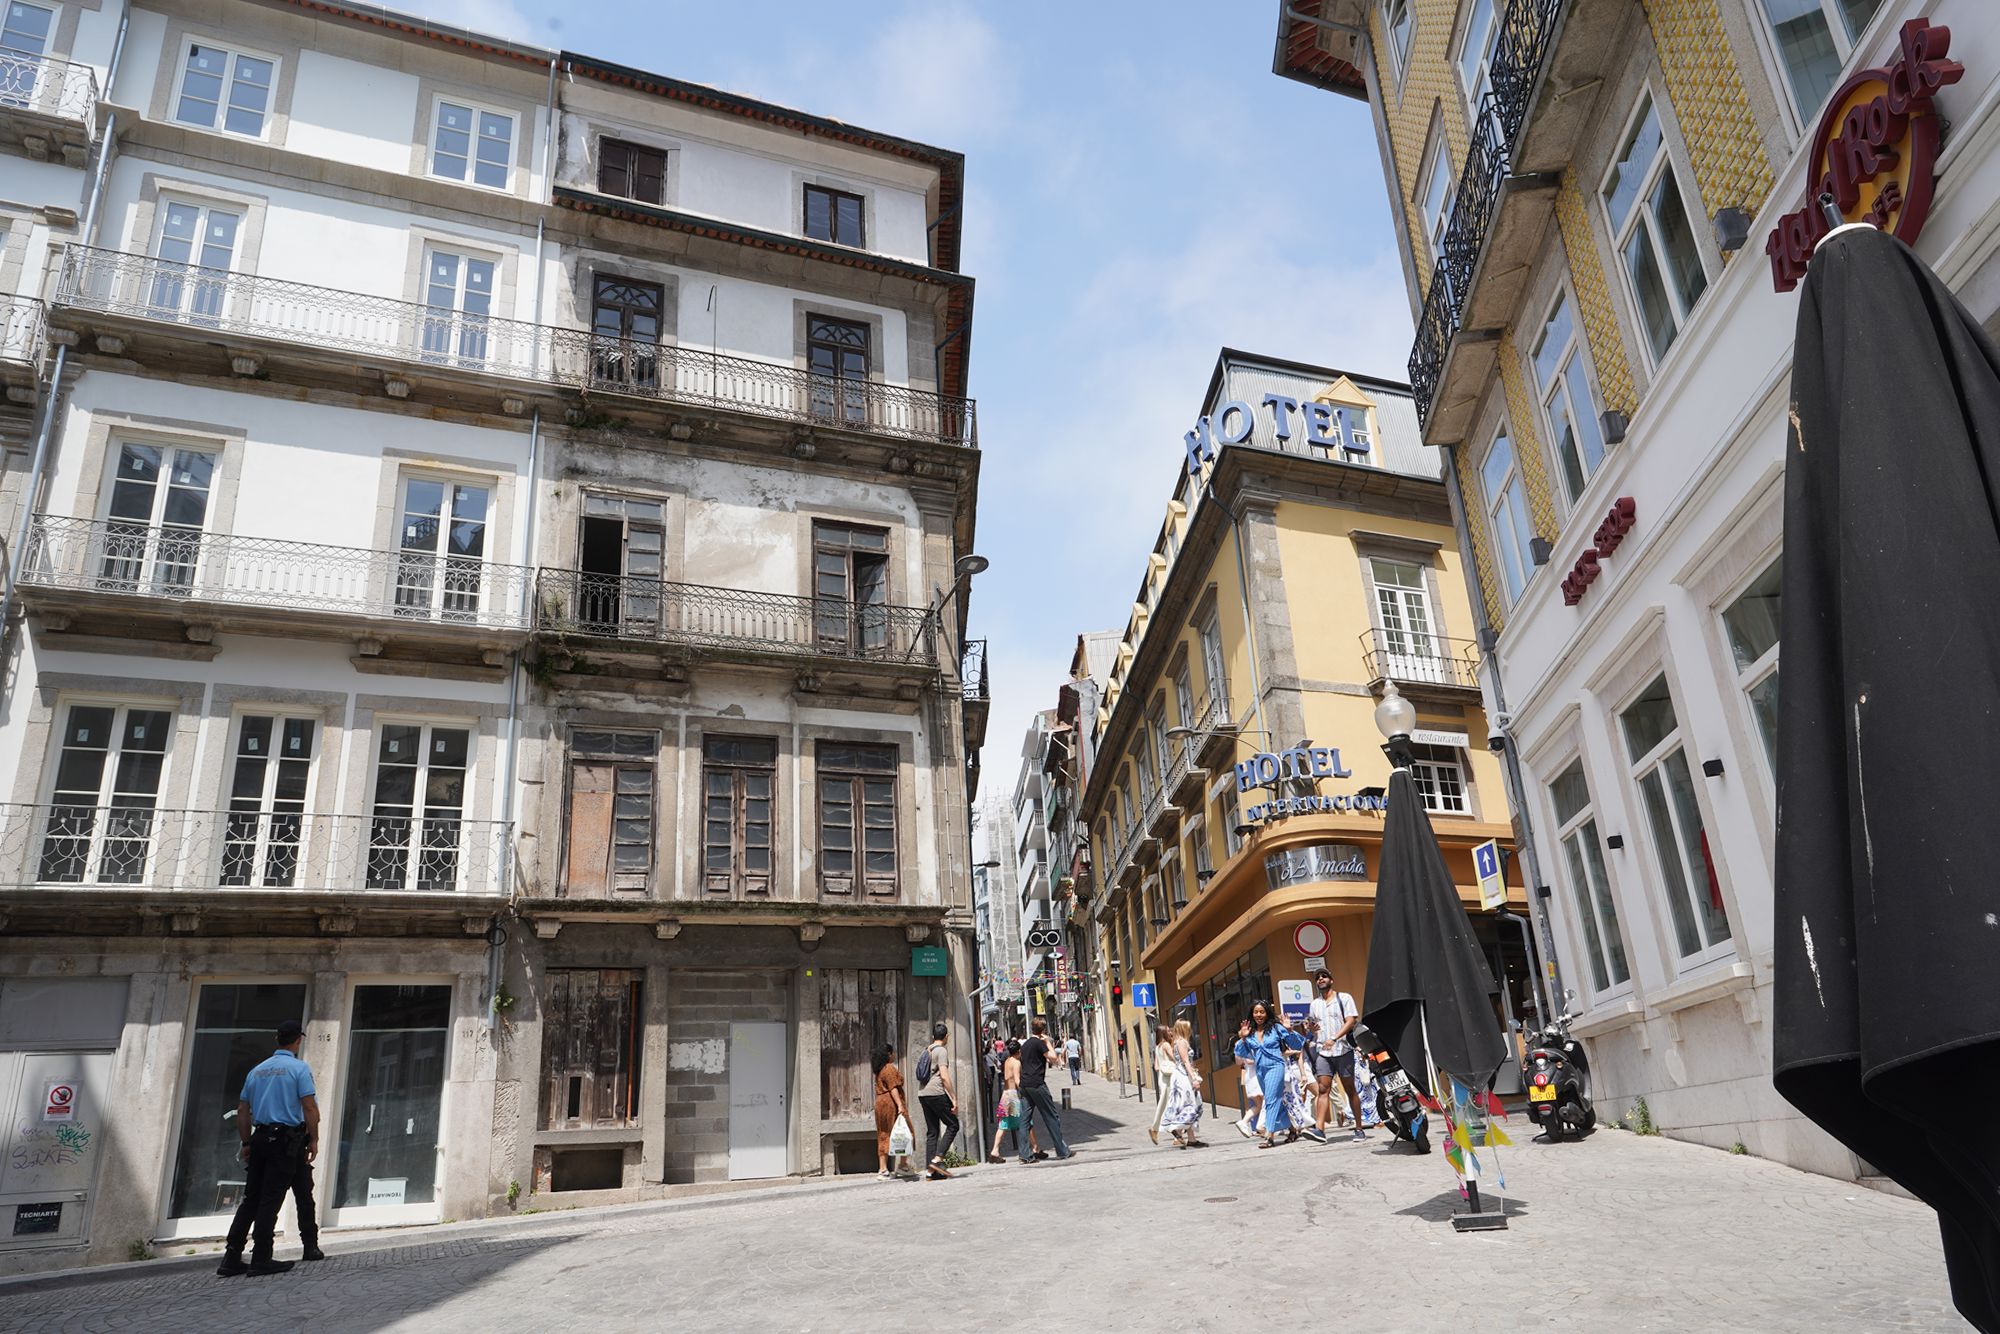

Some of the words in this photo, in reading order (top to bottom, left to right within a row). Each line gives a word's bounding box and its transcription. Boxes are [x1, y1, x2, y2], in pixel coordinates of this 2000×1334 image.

[1183, 393, 1370, 476] HOTEL
[1418, 733, 1464, 745] restaurante
[1235, 748, 1352, 793] HOTEL
[20, 1210, 59, 1218] TECNIARTE
